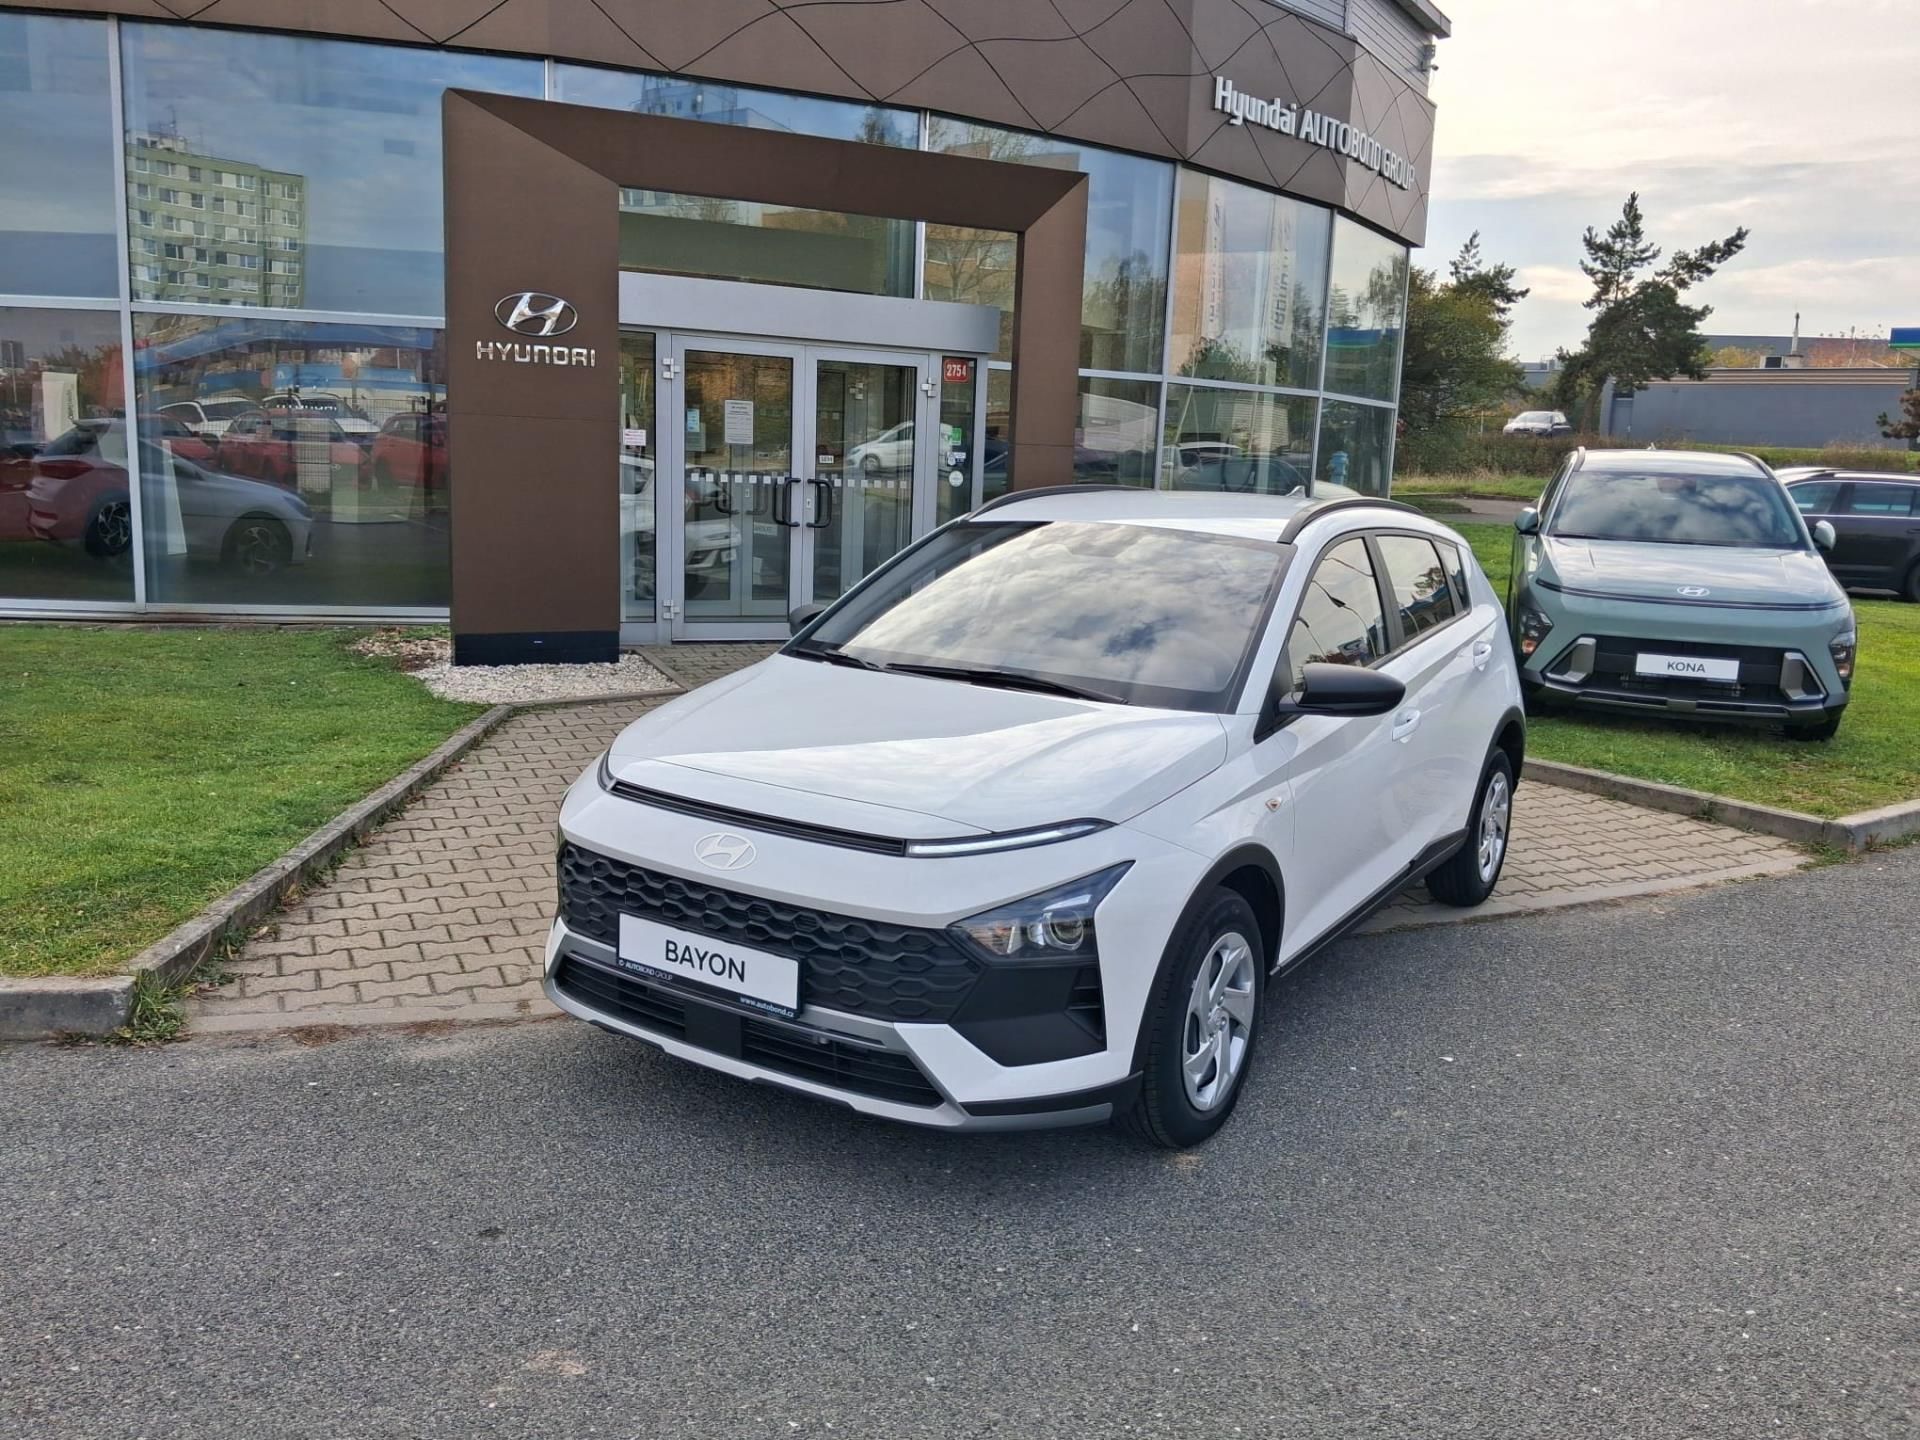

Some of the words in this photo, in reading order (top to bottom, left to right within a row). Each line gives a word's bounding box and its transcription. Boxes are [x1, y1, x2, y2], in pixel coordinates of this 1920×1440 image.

[1214, 75, 1297, 136] Hyundai
[1299, 109, 1381, 171] AUTOBOND
[1382, 148, 1416, 190] GROUP
[476, 340, 596, 368] HYUNDAI
[946, 364, 967, 377] 2754
[1666, 660, 1706, 673] KONA
[664, 939, 746, 983] BAYON
